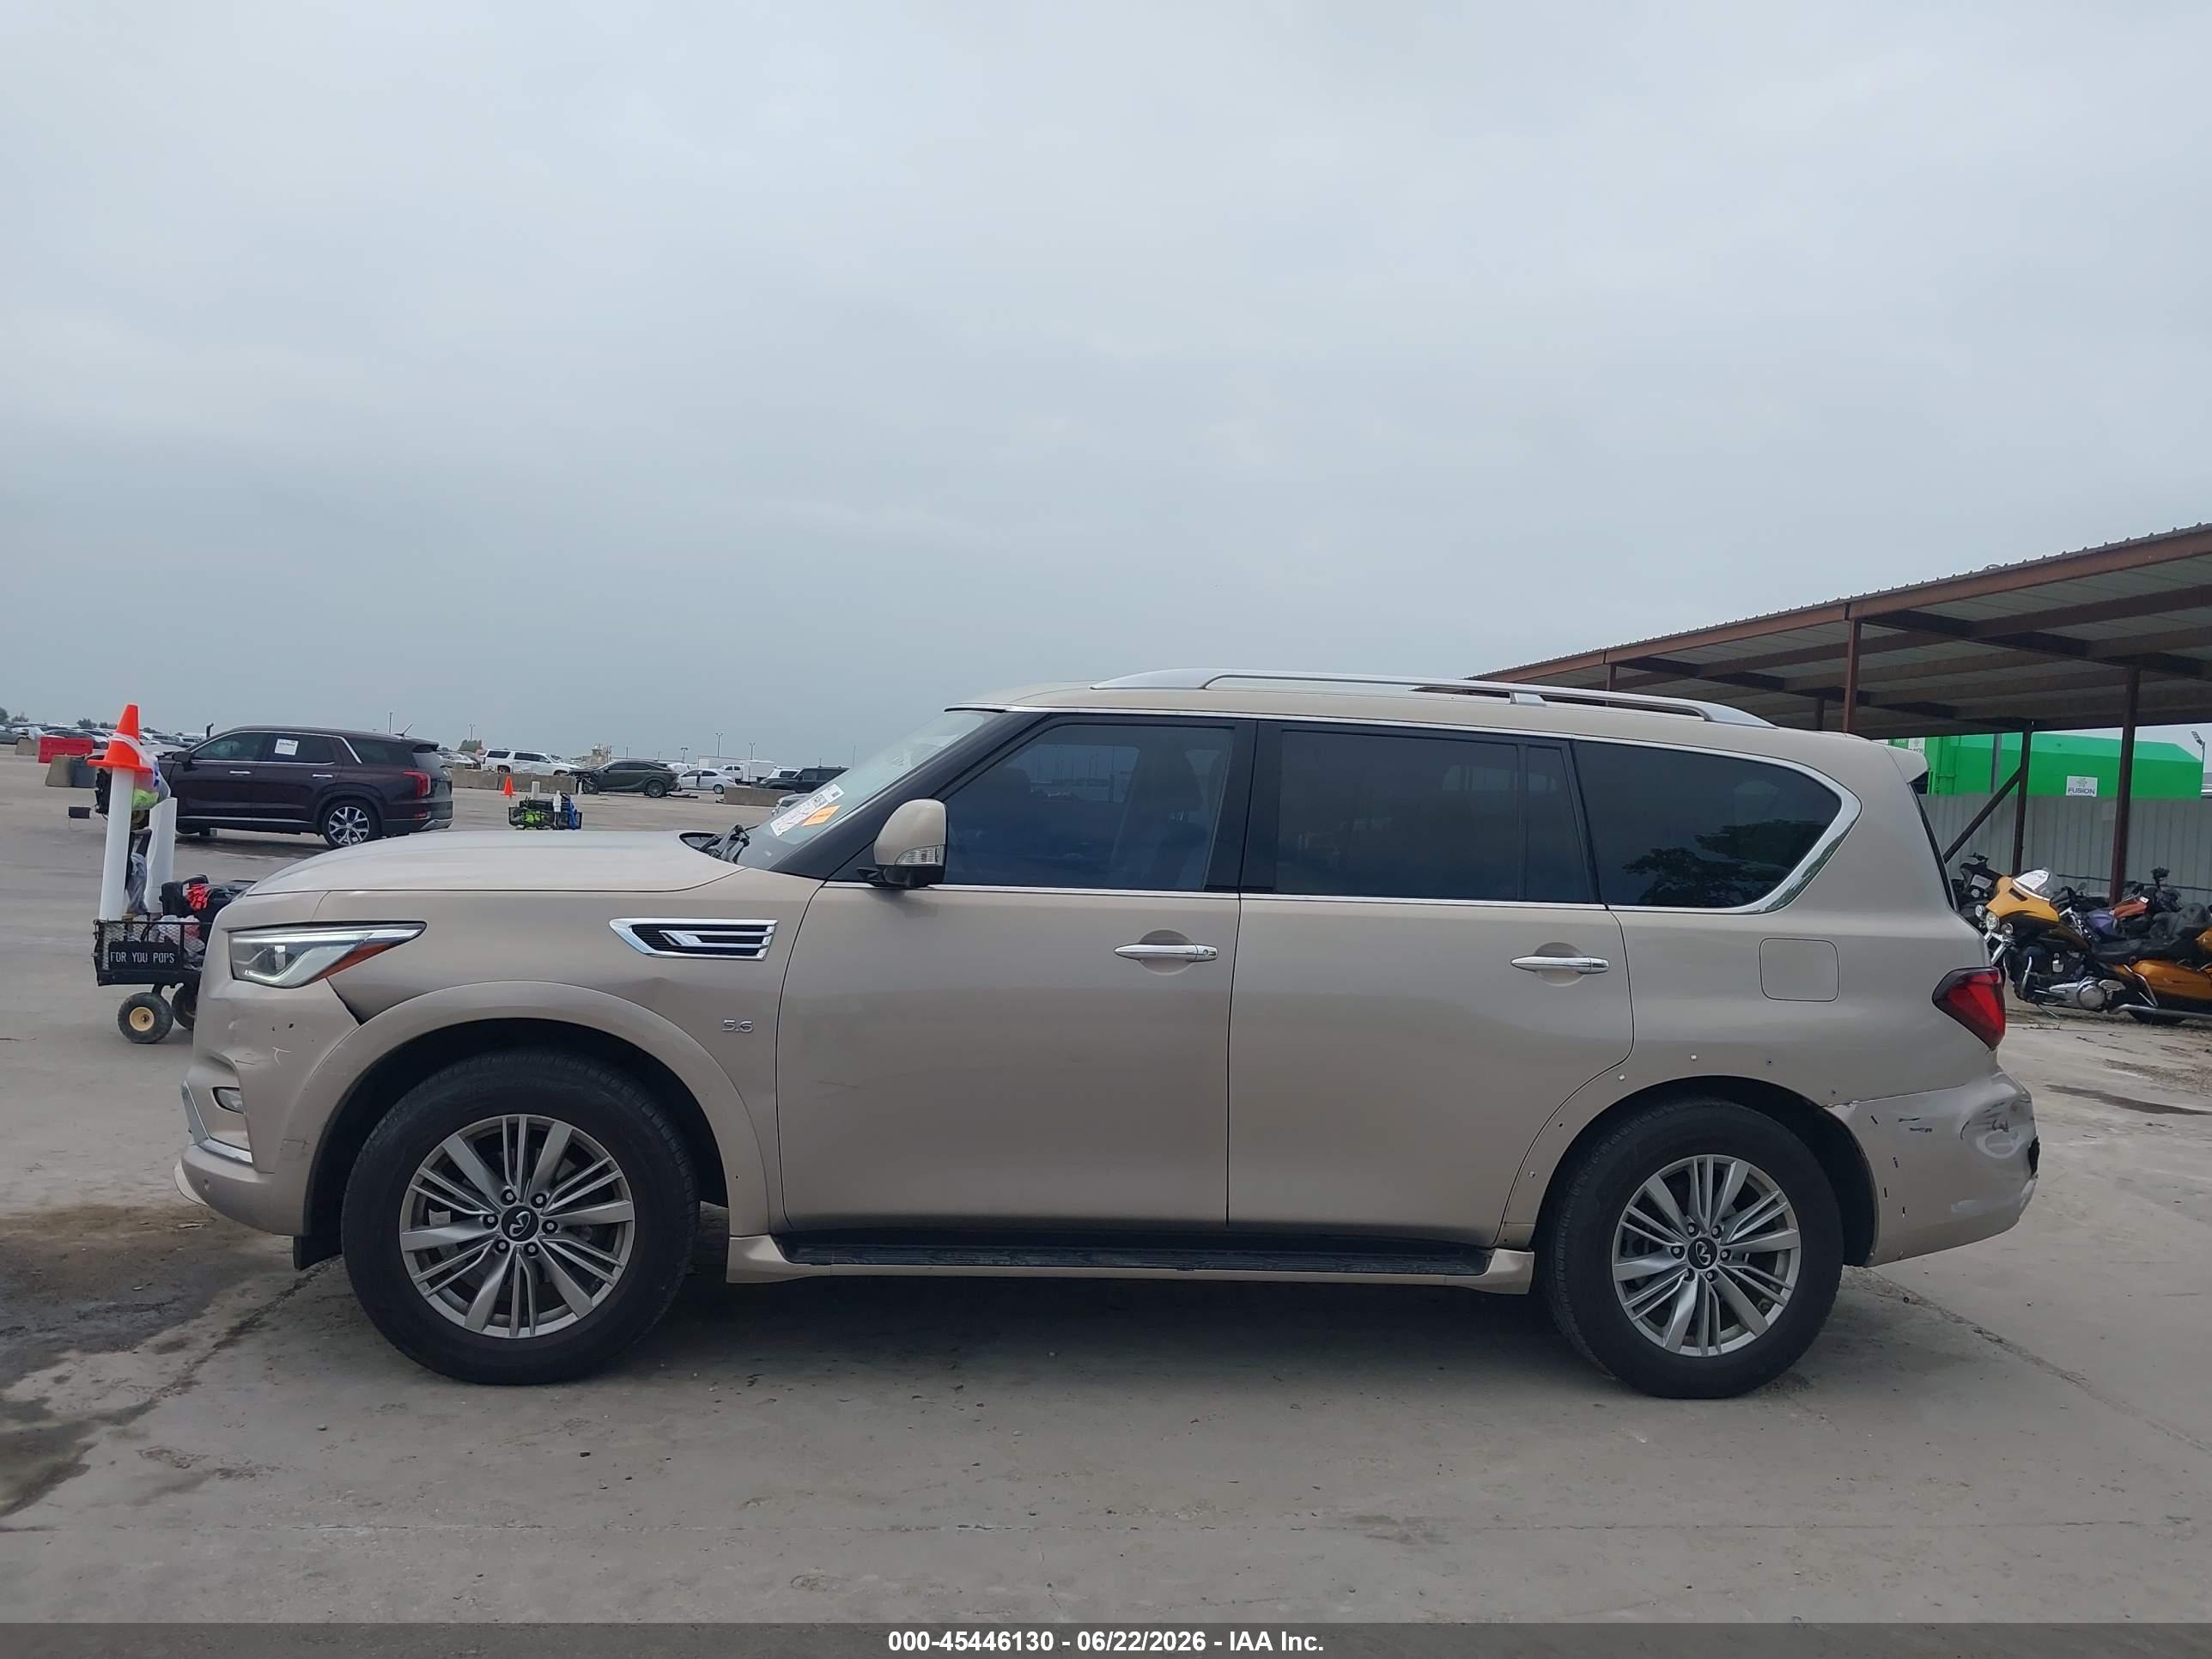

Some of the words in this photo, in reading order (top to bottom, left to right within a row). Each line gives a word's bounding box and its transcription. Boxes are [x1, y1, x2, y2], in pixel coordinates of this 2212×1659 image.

[110, 951, 127, 963] FOR
[131, 951, 149, 963] YOU
[721, 1018, 754, 1032] 5.6
